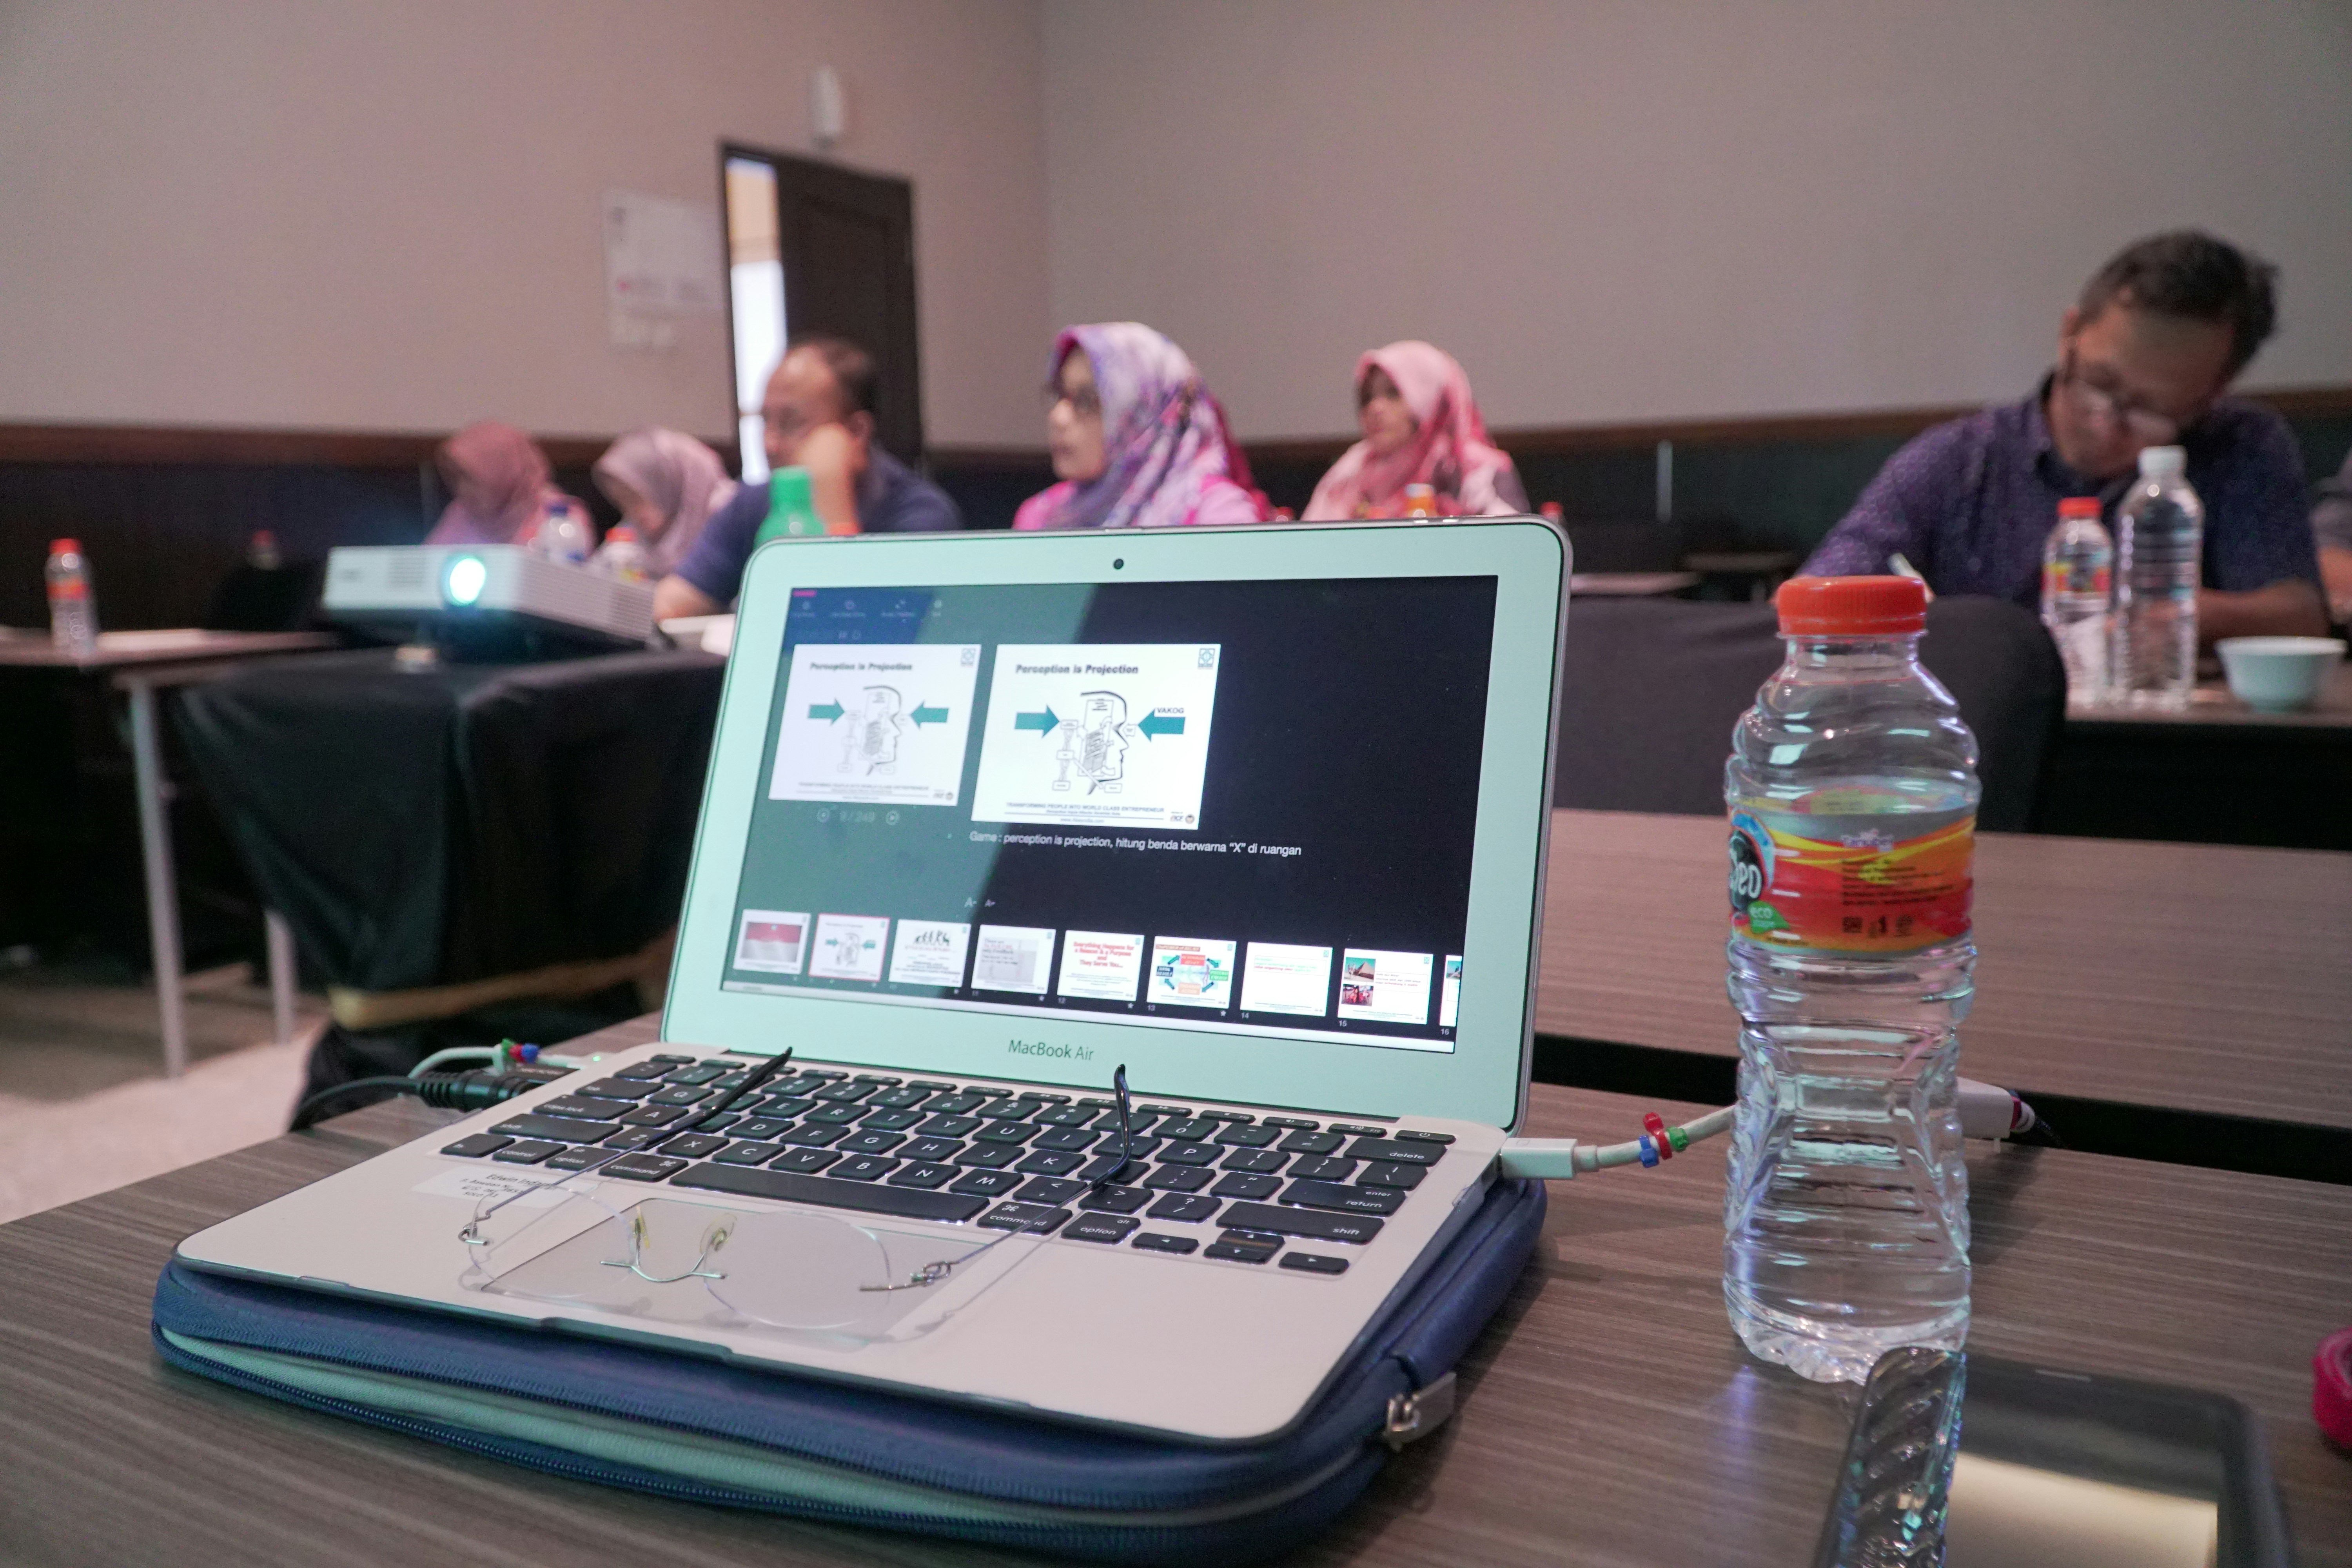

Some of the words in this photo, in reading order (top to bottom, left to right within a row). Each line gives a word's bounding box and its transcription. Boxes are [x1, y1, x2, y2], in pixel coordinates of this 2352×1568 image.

[809, 662, 855, 673] Perception
[858, 662, 865, 670] is
[868, 662, 913, 672] Projection
[1016, 664, 1069, 675] Perception
[1073, 665, 1082, 674] is
[1085, 665, 1139, 676] Projection
[969, 831, 997, 842] Game
[1003, 834, 1052, 845] perception
[1054, 835, 1063, 845] is
[1064, 836, 1113, 848] projection,
[1116, 837, 1145, 851] hitung
[1147, 838, 1178, 850] benda
[1181, 840, 1227, 852] berwarna
[1248, 844, 1258, 853] di
[1260, 846, 1301, 857] ruangan
[1008, 1040, 1072, 1058] MacBook
[1074, 1046, 1094, 1060] Air
[610, 1165, 661, 1175] command
[486, 1174, 518, 1182] Edwin
[1080, 1226, 1116, 1236] option
